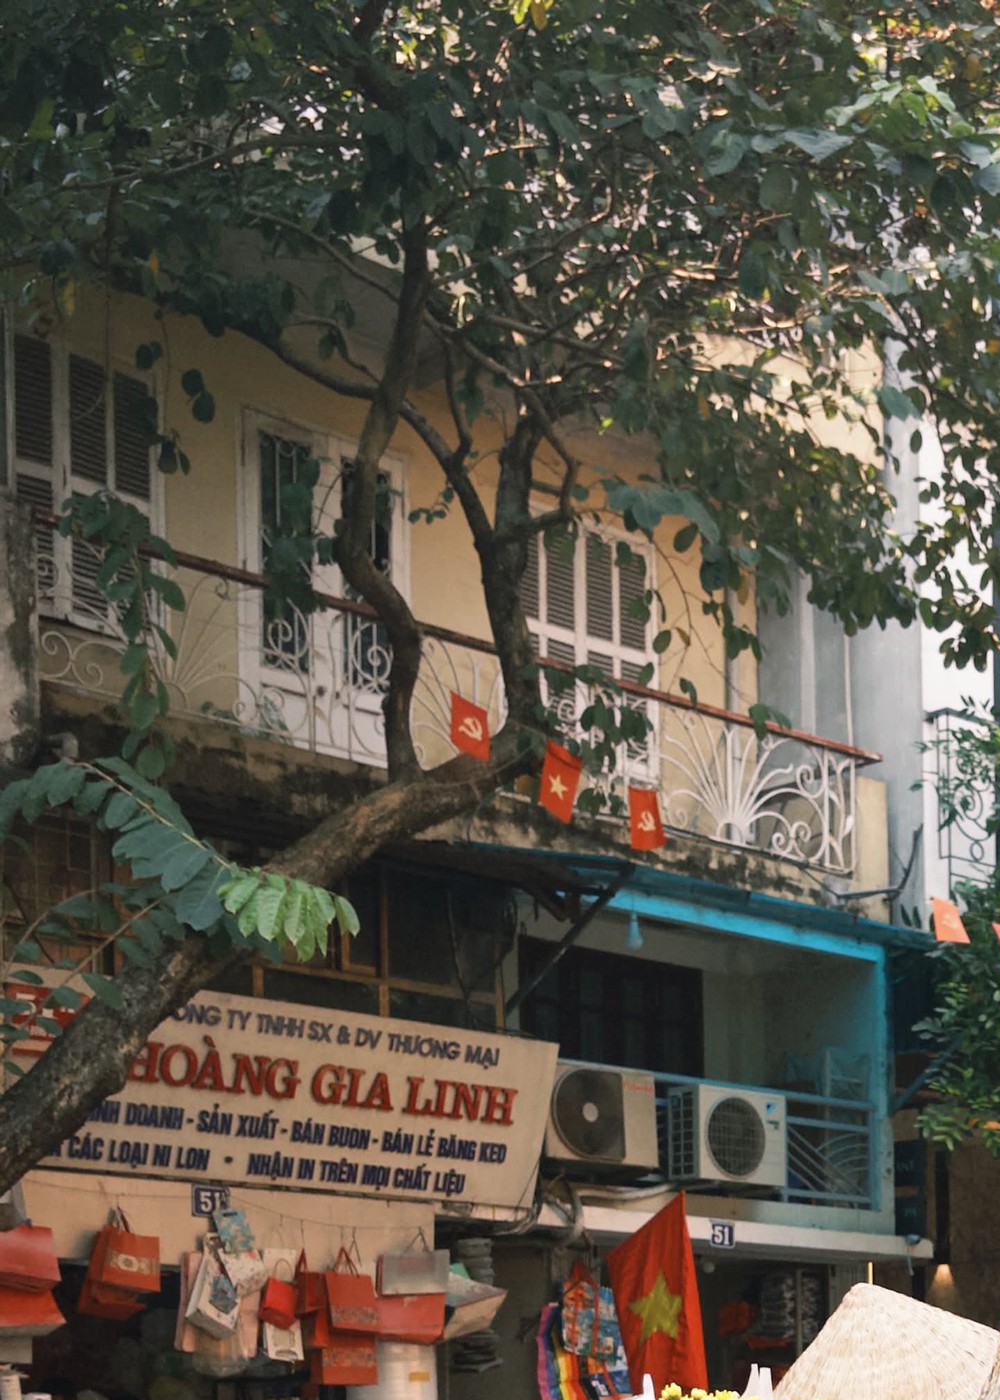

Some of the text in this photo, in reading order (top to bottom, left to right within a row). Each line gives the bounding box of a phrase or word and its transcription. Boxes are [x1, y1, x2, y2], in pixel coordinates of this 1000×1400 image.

[227, 1008, 251, 1030] TY
[256, 1013, 304, 1038] TNHH
[308, 1020, 334, 1045] SX
[337, 1024, 351, 1046] &
[355, 1028, 382, 1050] DV
[128, 1034, 519, 1127] HOÀNG GIA LINH
[68, 1131, 105, 1161] CÁC
[108, 1138, 150, 1168] LOẠI
[152, 1143, 173, 1167] NI
[175, 1147, 211, 1171] LON
[297, 1157, 315, 1181] IN
[319, 1158, 358, 1184] TRÊN
[361, 1164, 391, 1191] MỌI
[125, 1102, 185, 1130] DOANH
[196, 1103, 233, 1136] SẢN
[235, 1109, 280, 1140] XUẤT
[290, 1117, 326, 1145] BÁN
[382, 1128, 415, 1155] BÁN
[478, 1142, 508, 1165] KEO
[713, 1226, 730, 1245] 51
